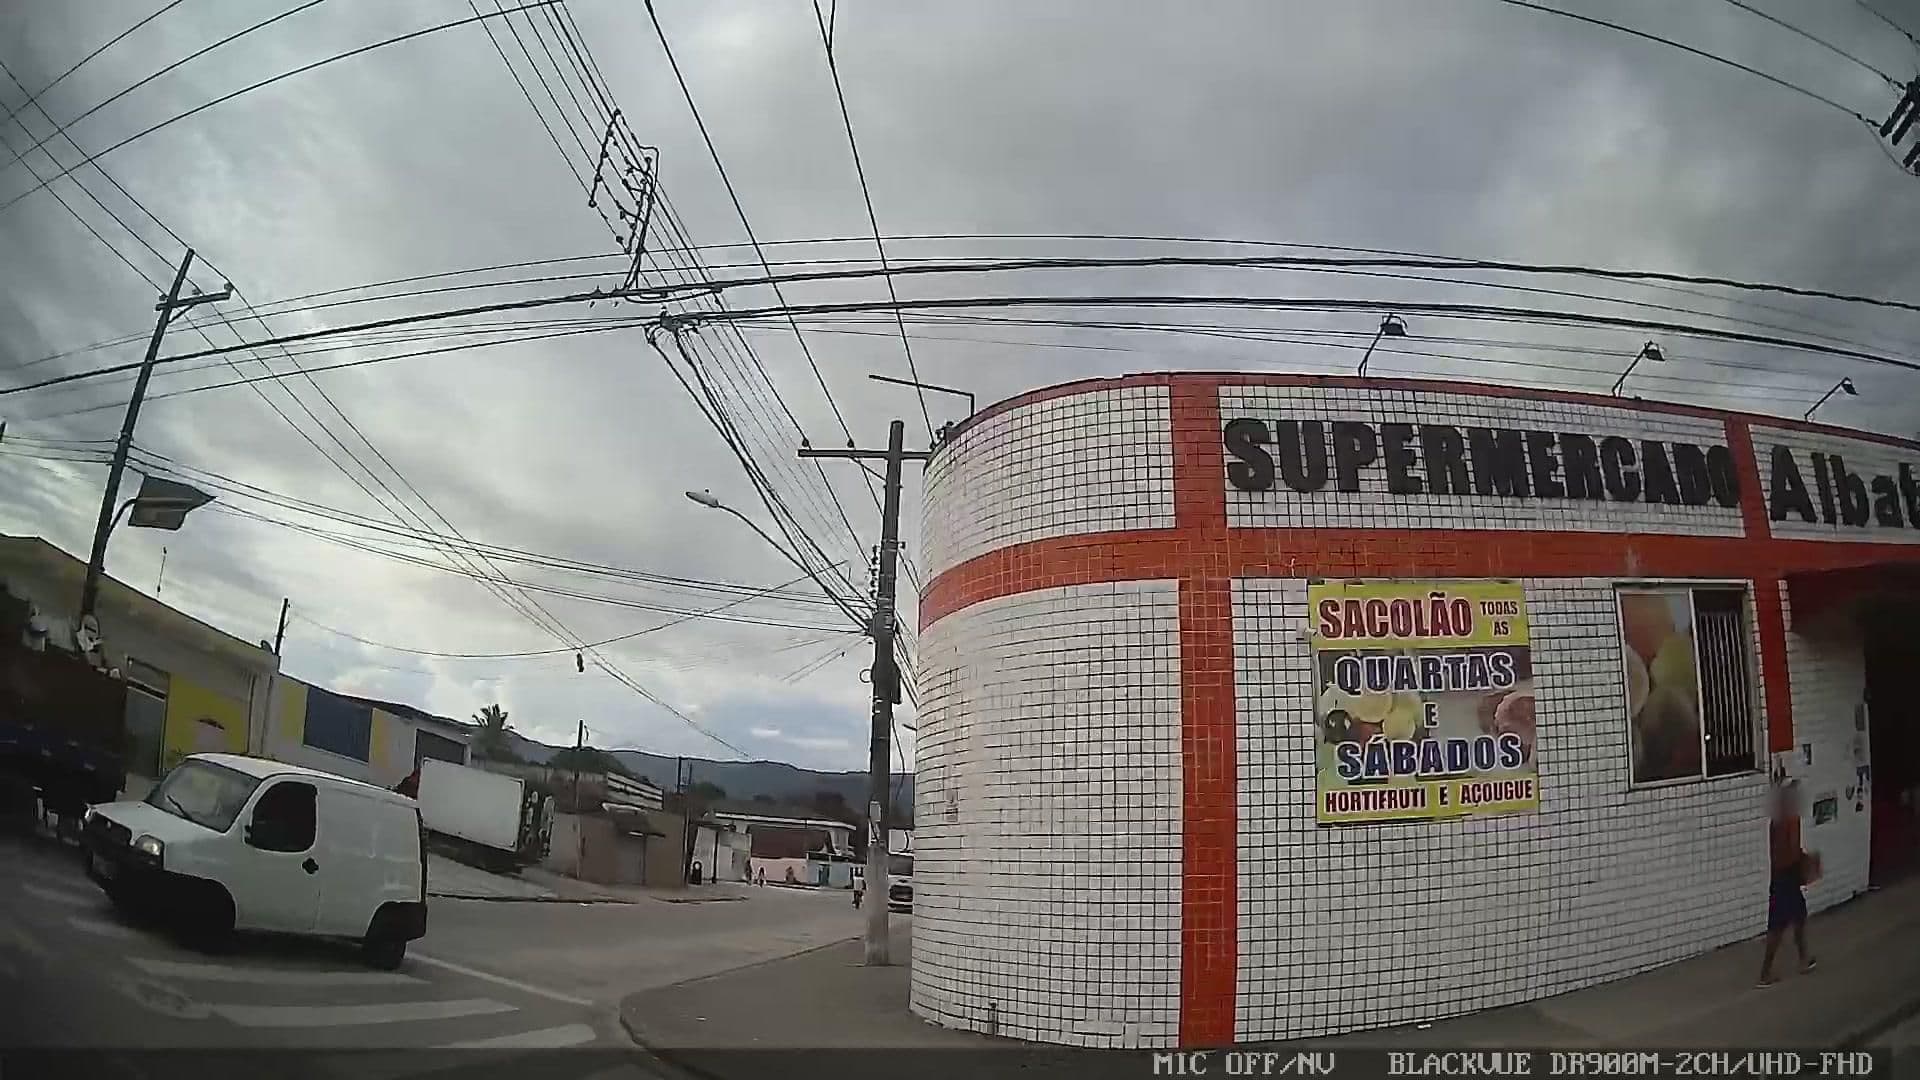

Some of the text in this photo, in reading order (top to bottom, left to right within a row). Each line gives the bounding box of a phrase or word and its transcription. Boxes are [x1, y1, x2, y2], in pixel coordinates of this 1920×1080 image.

[1223, 418, 1740, 507] SUPERMERCADO
[1319, 592, 1472, 638] SACOLÃO
[1480, 600, 1518, 616] TODAS
[1494, 621, 1509, 635] AS
[1336, 652, 1515, 695] QUARTAS
[1424, 702, 1438, 728] E
[1337, 733, 1522, 780] SÁBADOS
[1439, 786, 1448, 805] E
[1460, 779, 1533, 808] AÇOUGUE
